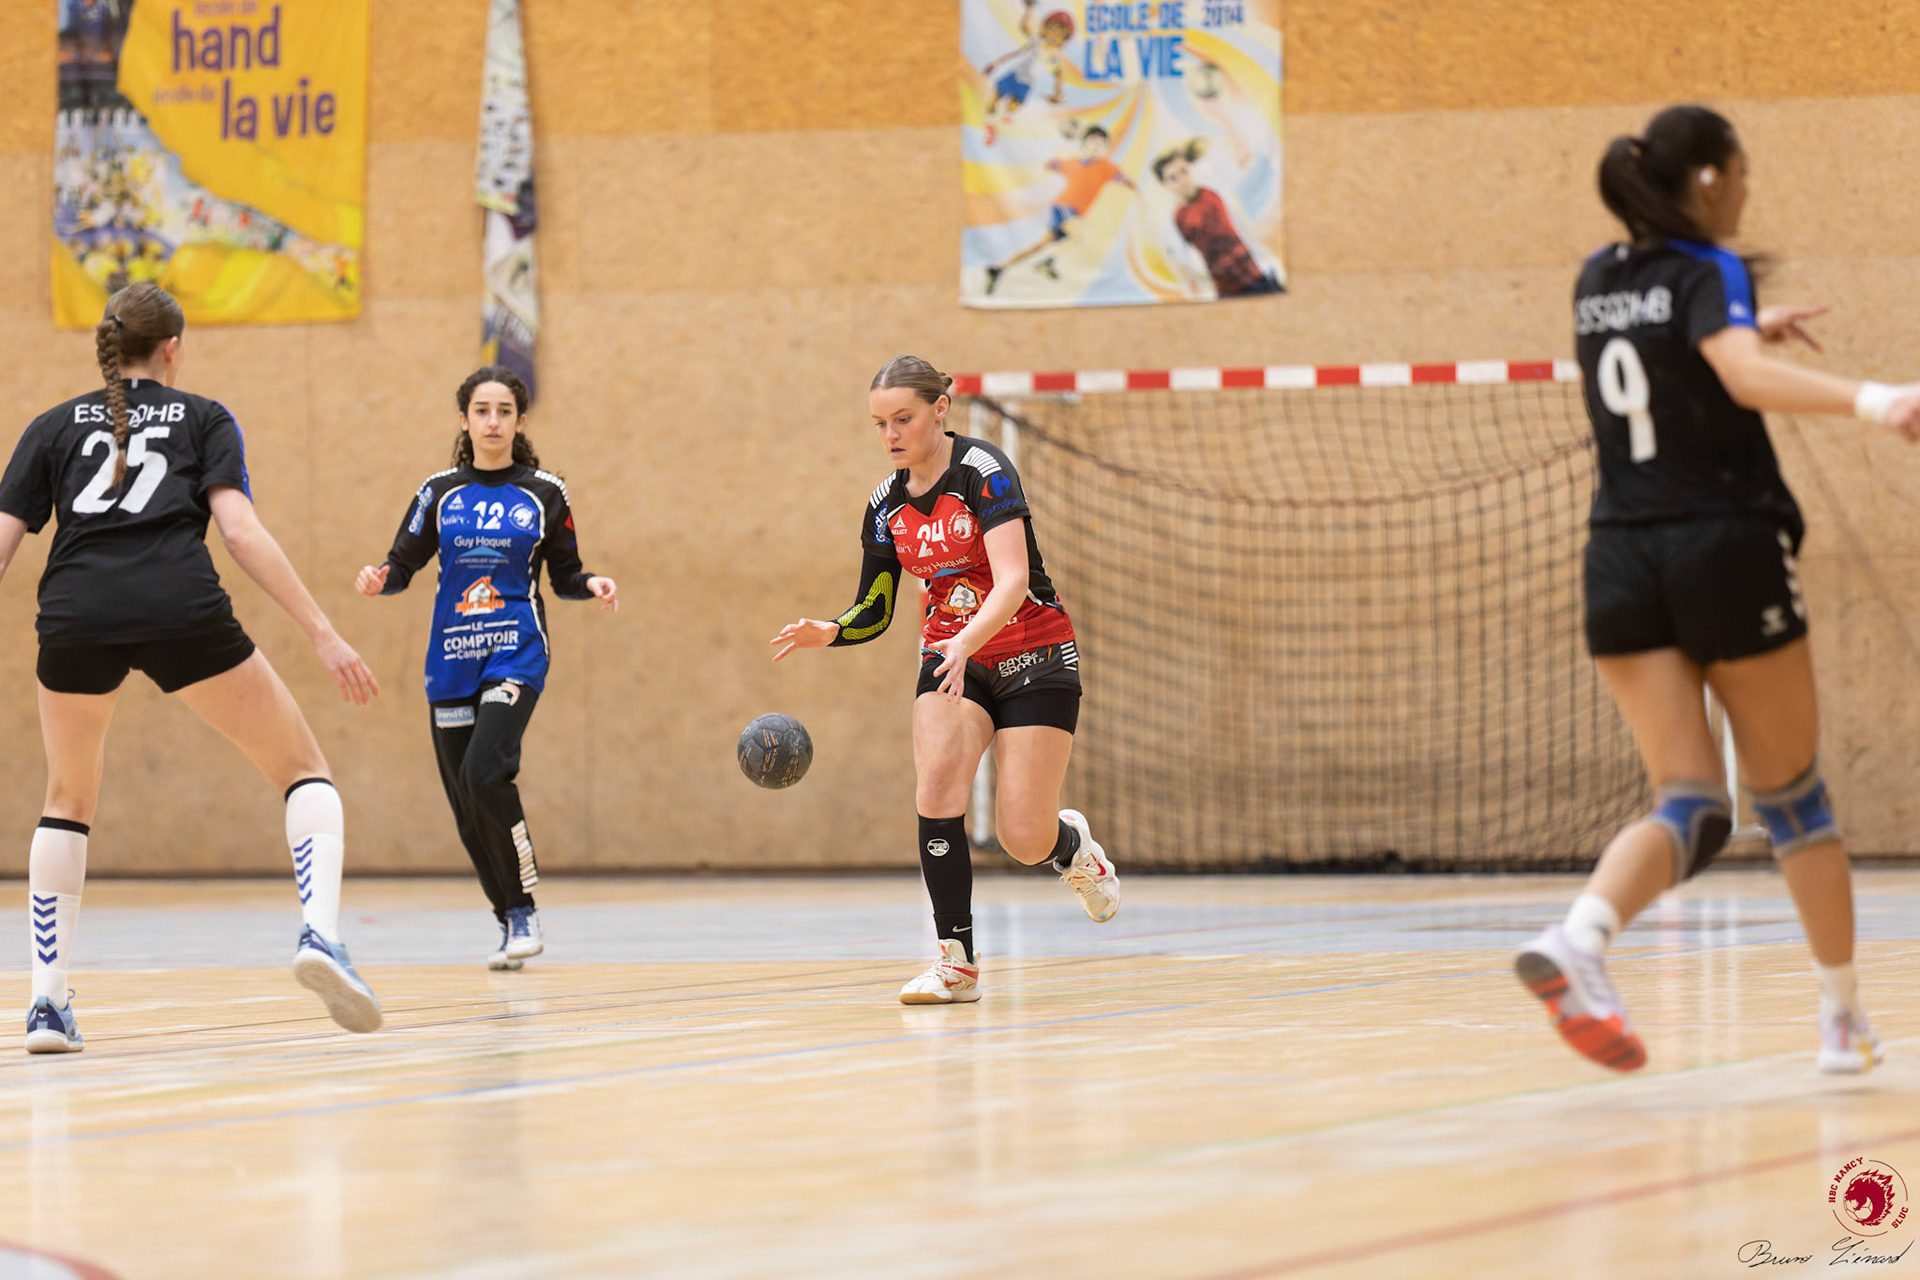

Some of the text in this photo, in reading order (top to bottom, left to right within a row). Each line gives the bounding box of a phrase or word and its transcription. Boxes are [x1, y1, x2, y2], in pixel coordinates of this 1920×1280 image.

[1159, 2, 1184, 29] DE
[1203, 4, 1243, 28] 2014
[172, 5, 282, 73] hand
[1084, 36, 1183, 79] LA VIE
[221, 76, 336, 141] la vie
[1597, 337, 1658, 463] 9
[71, 426, 170, 514] 25
[472, 501, 505, 530] 12
[453, 536, 512, 549] Guy Hoquet
[917, 519, 949, 558] 24
[911, 555, 972, 574] Guy Hoquet
[471, 621, 484, 632] LE
[443, 630, 519, 652] COMPTOIR
[998, 652, 1031, 671] PAYS
